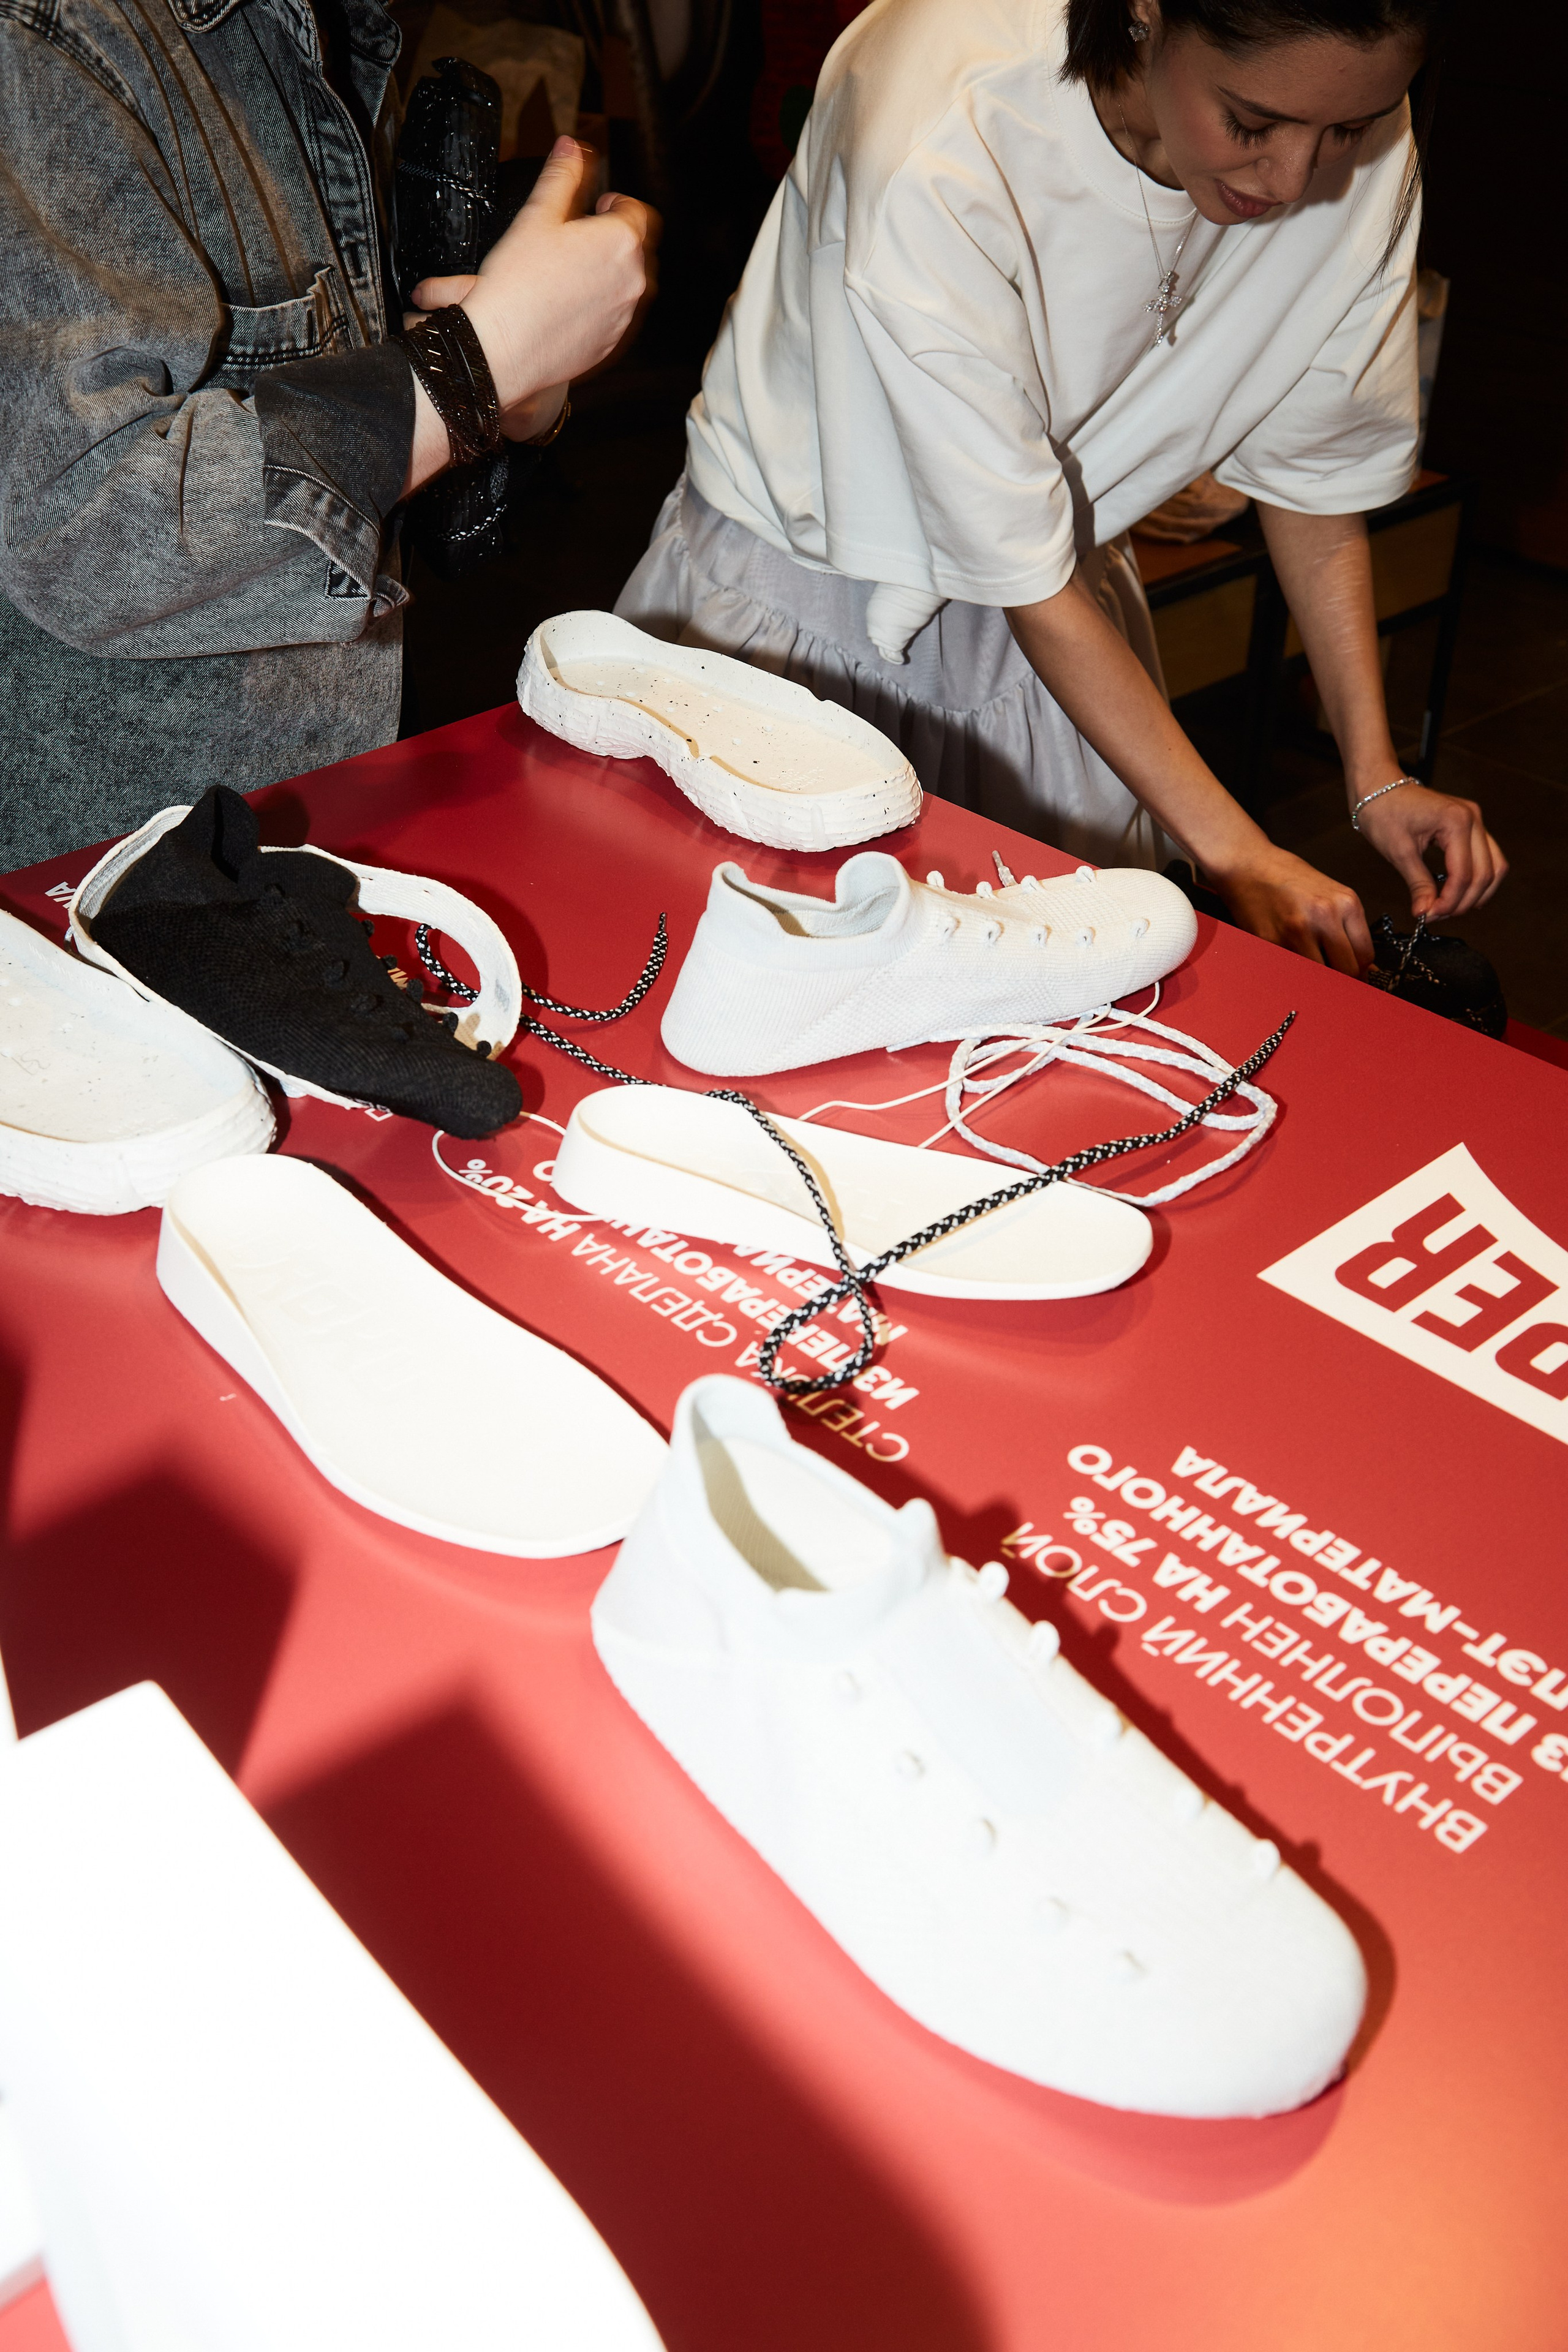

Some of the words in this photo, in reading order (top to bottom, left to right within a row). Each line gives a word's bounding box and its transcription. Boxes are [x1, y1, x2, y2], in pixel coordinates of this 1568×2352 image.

[458, 1159, 535, 1208] 20%
[521, 1200, 581, 1242] НА
[571, 1233, 737, 1347] СДЕЛАНА
[853, 1366, 919, 1410] ИЗ
[1000, 1521, 1147, 1622] СЛОЙ
[1063, 1496, 1158, 1567] 75%
[1152, 1551, 1231, 1613] НА
[1171, 1446, 1568, 1711] ПЭТ-МАТЕРИАЛА
[1067, 1444, 1537, 1746] ПЕРЕРАБОТАННОГО
[1140, 1616, 1488, 1853] ВНУТРЕННИЙ
[1221, 1602, 1524, 1805] ВЫПОЛНЕН
